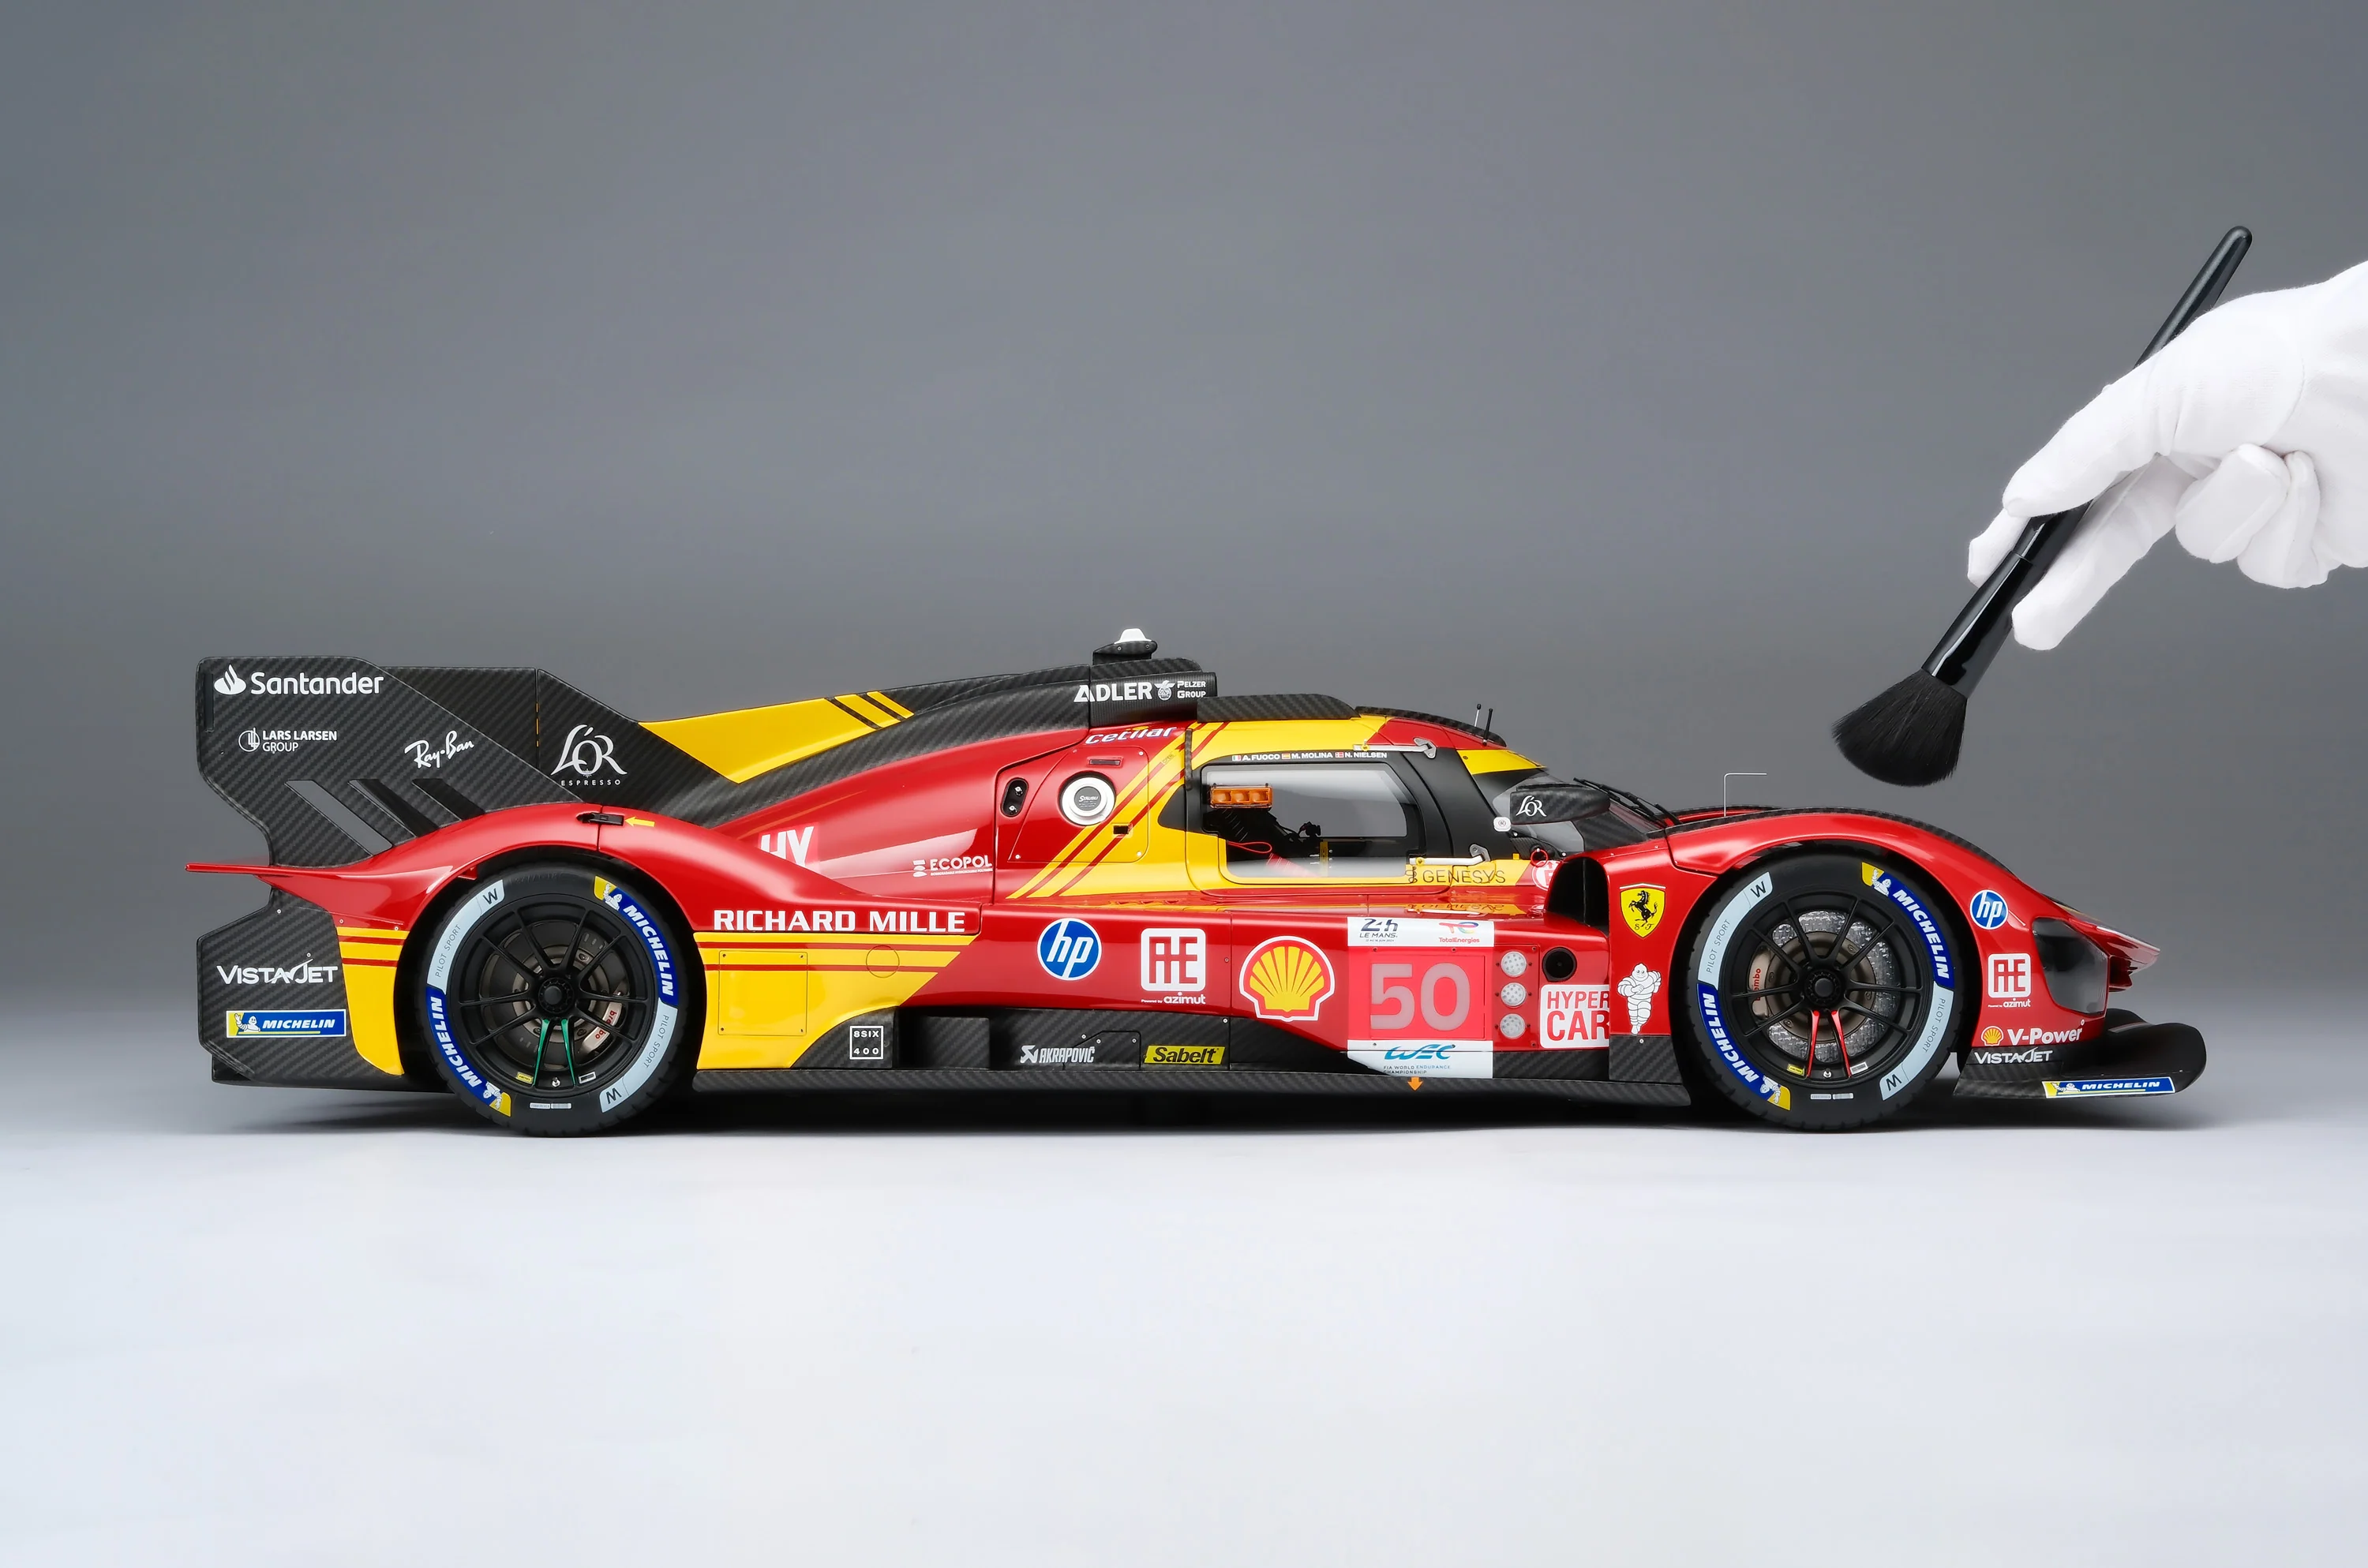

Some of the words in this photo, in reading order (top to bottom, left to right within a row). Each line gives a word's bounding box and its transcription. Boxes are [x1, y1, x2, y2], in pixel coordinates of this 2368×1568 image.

[250, 672, 384, 695] Santander
[1073, 682, 1152, 702] ADLER
[262, 731, 291, 740] LARS
[294, 731, 337, 740] LARSEN
[262, 742, 299, 752] GROUP
[930, 855, 992, 871] ECOPOL
[1422, 870, 1506, 884] GENESYS
[483, 888, 498, 905] W
[1751, 881, 1767, 898] W
[1976, 891, 2003, 928] hp
[714, 911, 856, 931] RICHARD
[870, 911, 965, 933] MILLE
[1893, 889, 1949, 979] MICHELIN
[435, 952, 447, 978] PILOT
[444, 924, 462, 951] SPORT
[622, 904, 674, 996] MICHELIN
[1046, 919, 1094, 979] hp
[1707, 947, 1718, 973] PILOT
[1714, 919, 1731, 946] SPORT
[1163, 992, 1205, 1005] azimut
[1370, 963, 1471, 1031] 50
[1547, 991, 1609, 1009] HYPER
[2003, 997, 2031, 1008] azimut
[1935, 998, 1946, 1024] PILOT
[262, 1020, 335, 1029] MICHELIN
[659, 1015, 669, 1040] PILOT
[853, 1030, 879, 1038] 8SIX
[1547, 1010, 1609, 1041] CAR
[430, 997, 483, 1087] MICHELIN
[1703, 993, 1759, 1083] MICHELIN
[1922, 1025, 1939, 1053] SPORT
[2007, 1027, 2082, 1046] V-Power
[644, 1042, 661, 1068] SPORT
[1153, 1046, 1216, 1063] Sabelt
[1384, 1044, 1454, 1060] WEC
[2082, 1081, 2160, 1090] MICHELIN
